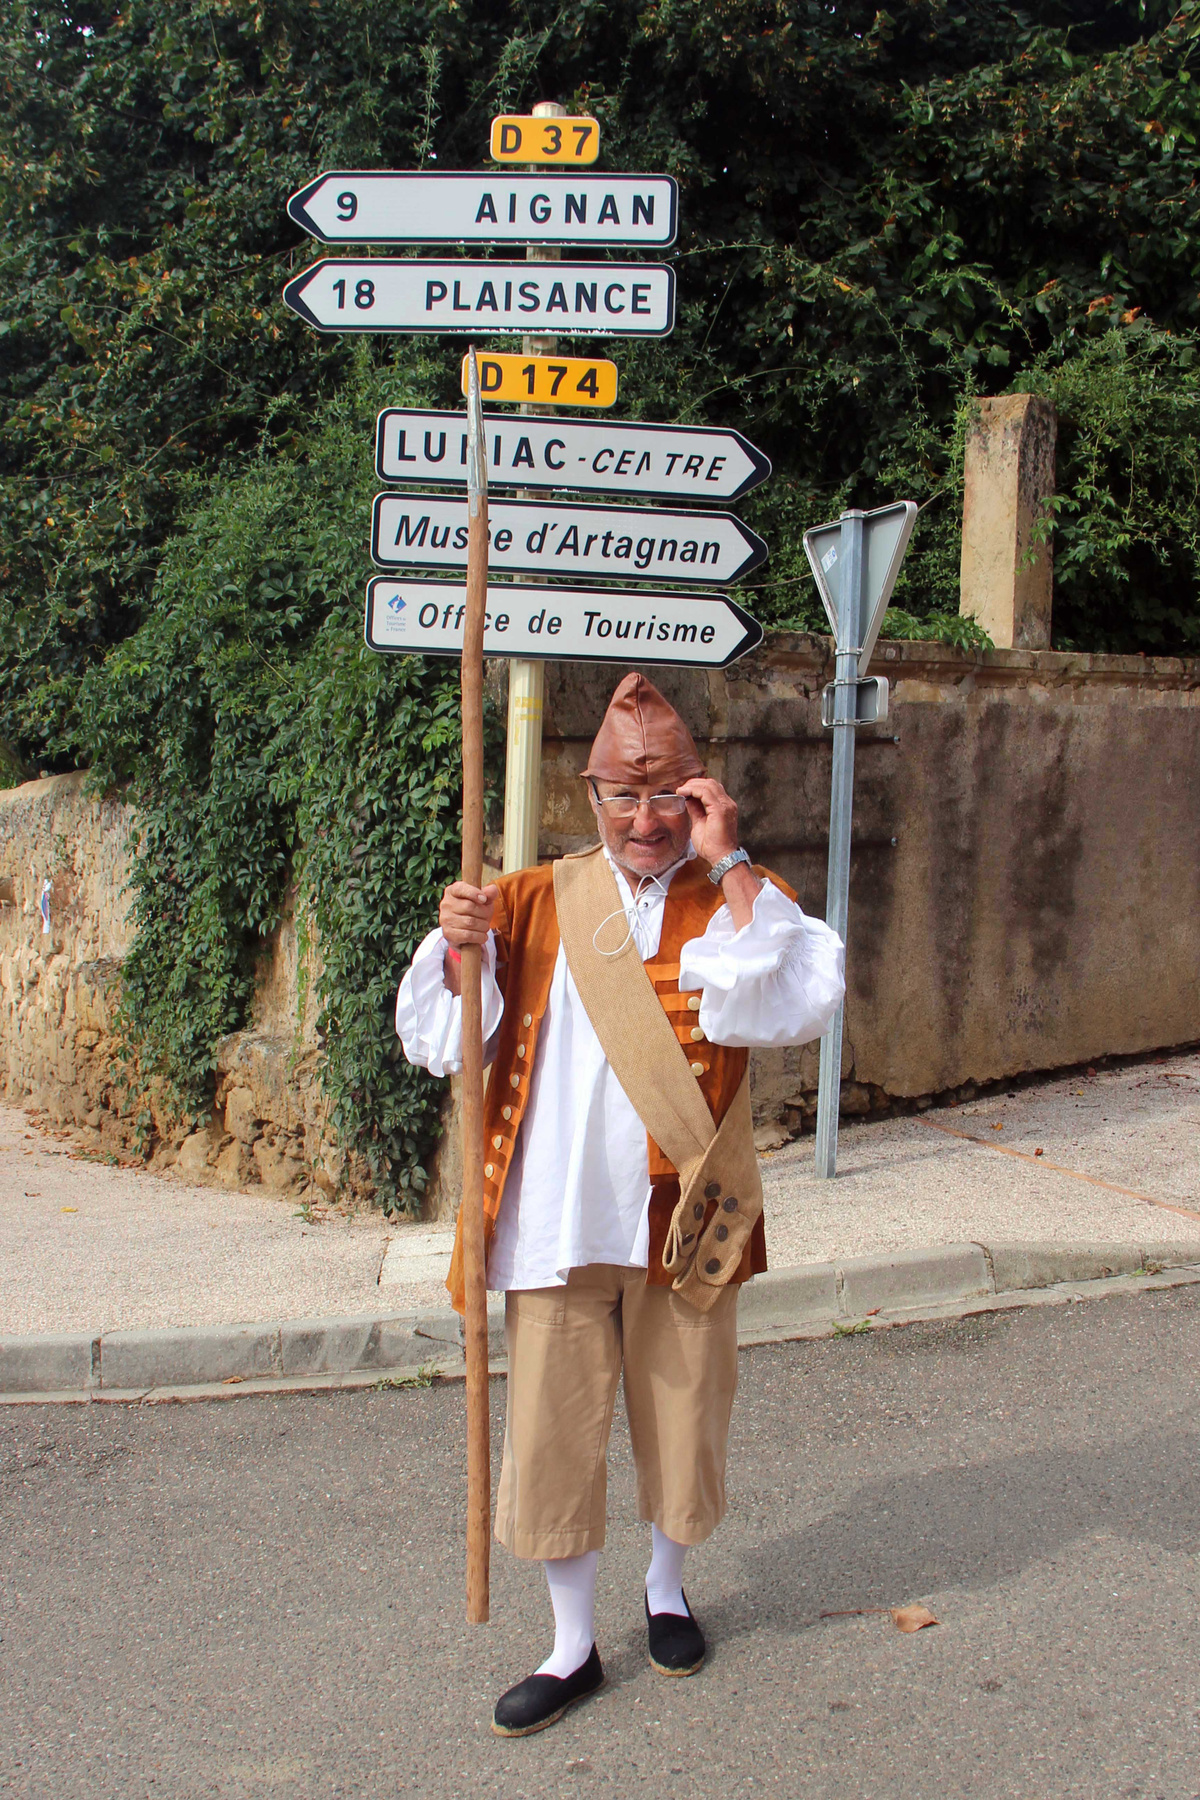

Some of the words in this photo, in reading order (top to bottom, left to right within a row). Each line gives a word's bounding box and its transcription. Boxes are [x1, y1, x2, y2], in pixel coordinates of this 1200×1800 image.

[500, 124, 522, 154] D
[541, 125, 592, 156] 37
[336, 191, 358, 222] 9
[475, 192, 655, 226] AIGNAN
[332, 279, 376, 310] 18
[425, 280, 652, 314] PLAISANCE
[480, 361, 503, 392] D
[522, 364, 599, 399] 174
[398, 430, 566, 470] LUIAC
[394, 515, 513, 552] Muse
[525, 523, 721, 569] d'Artagnan
[528, 609, 562, 635] de
[584, 611, 716, 644] Tourisme
